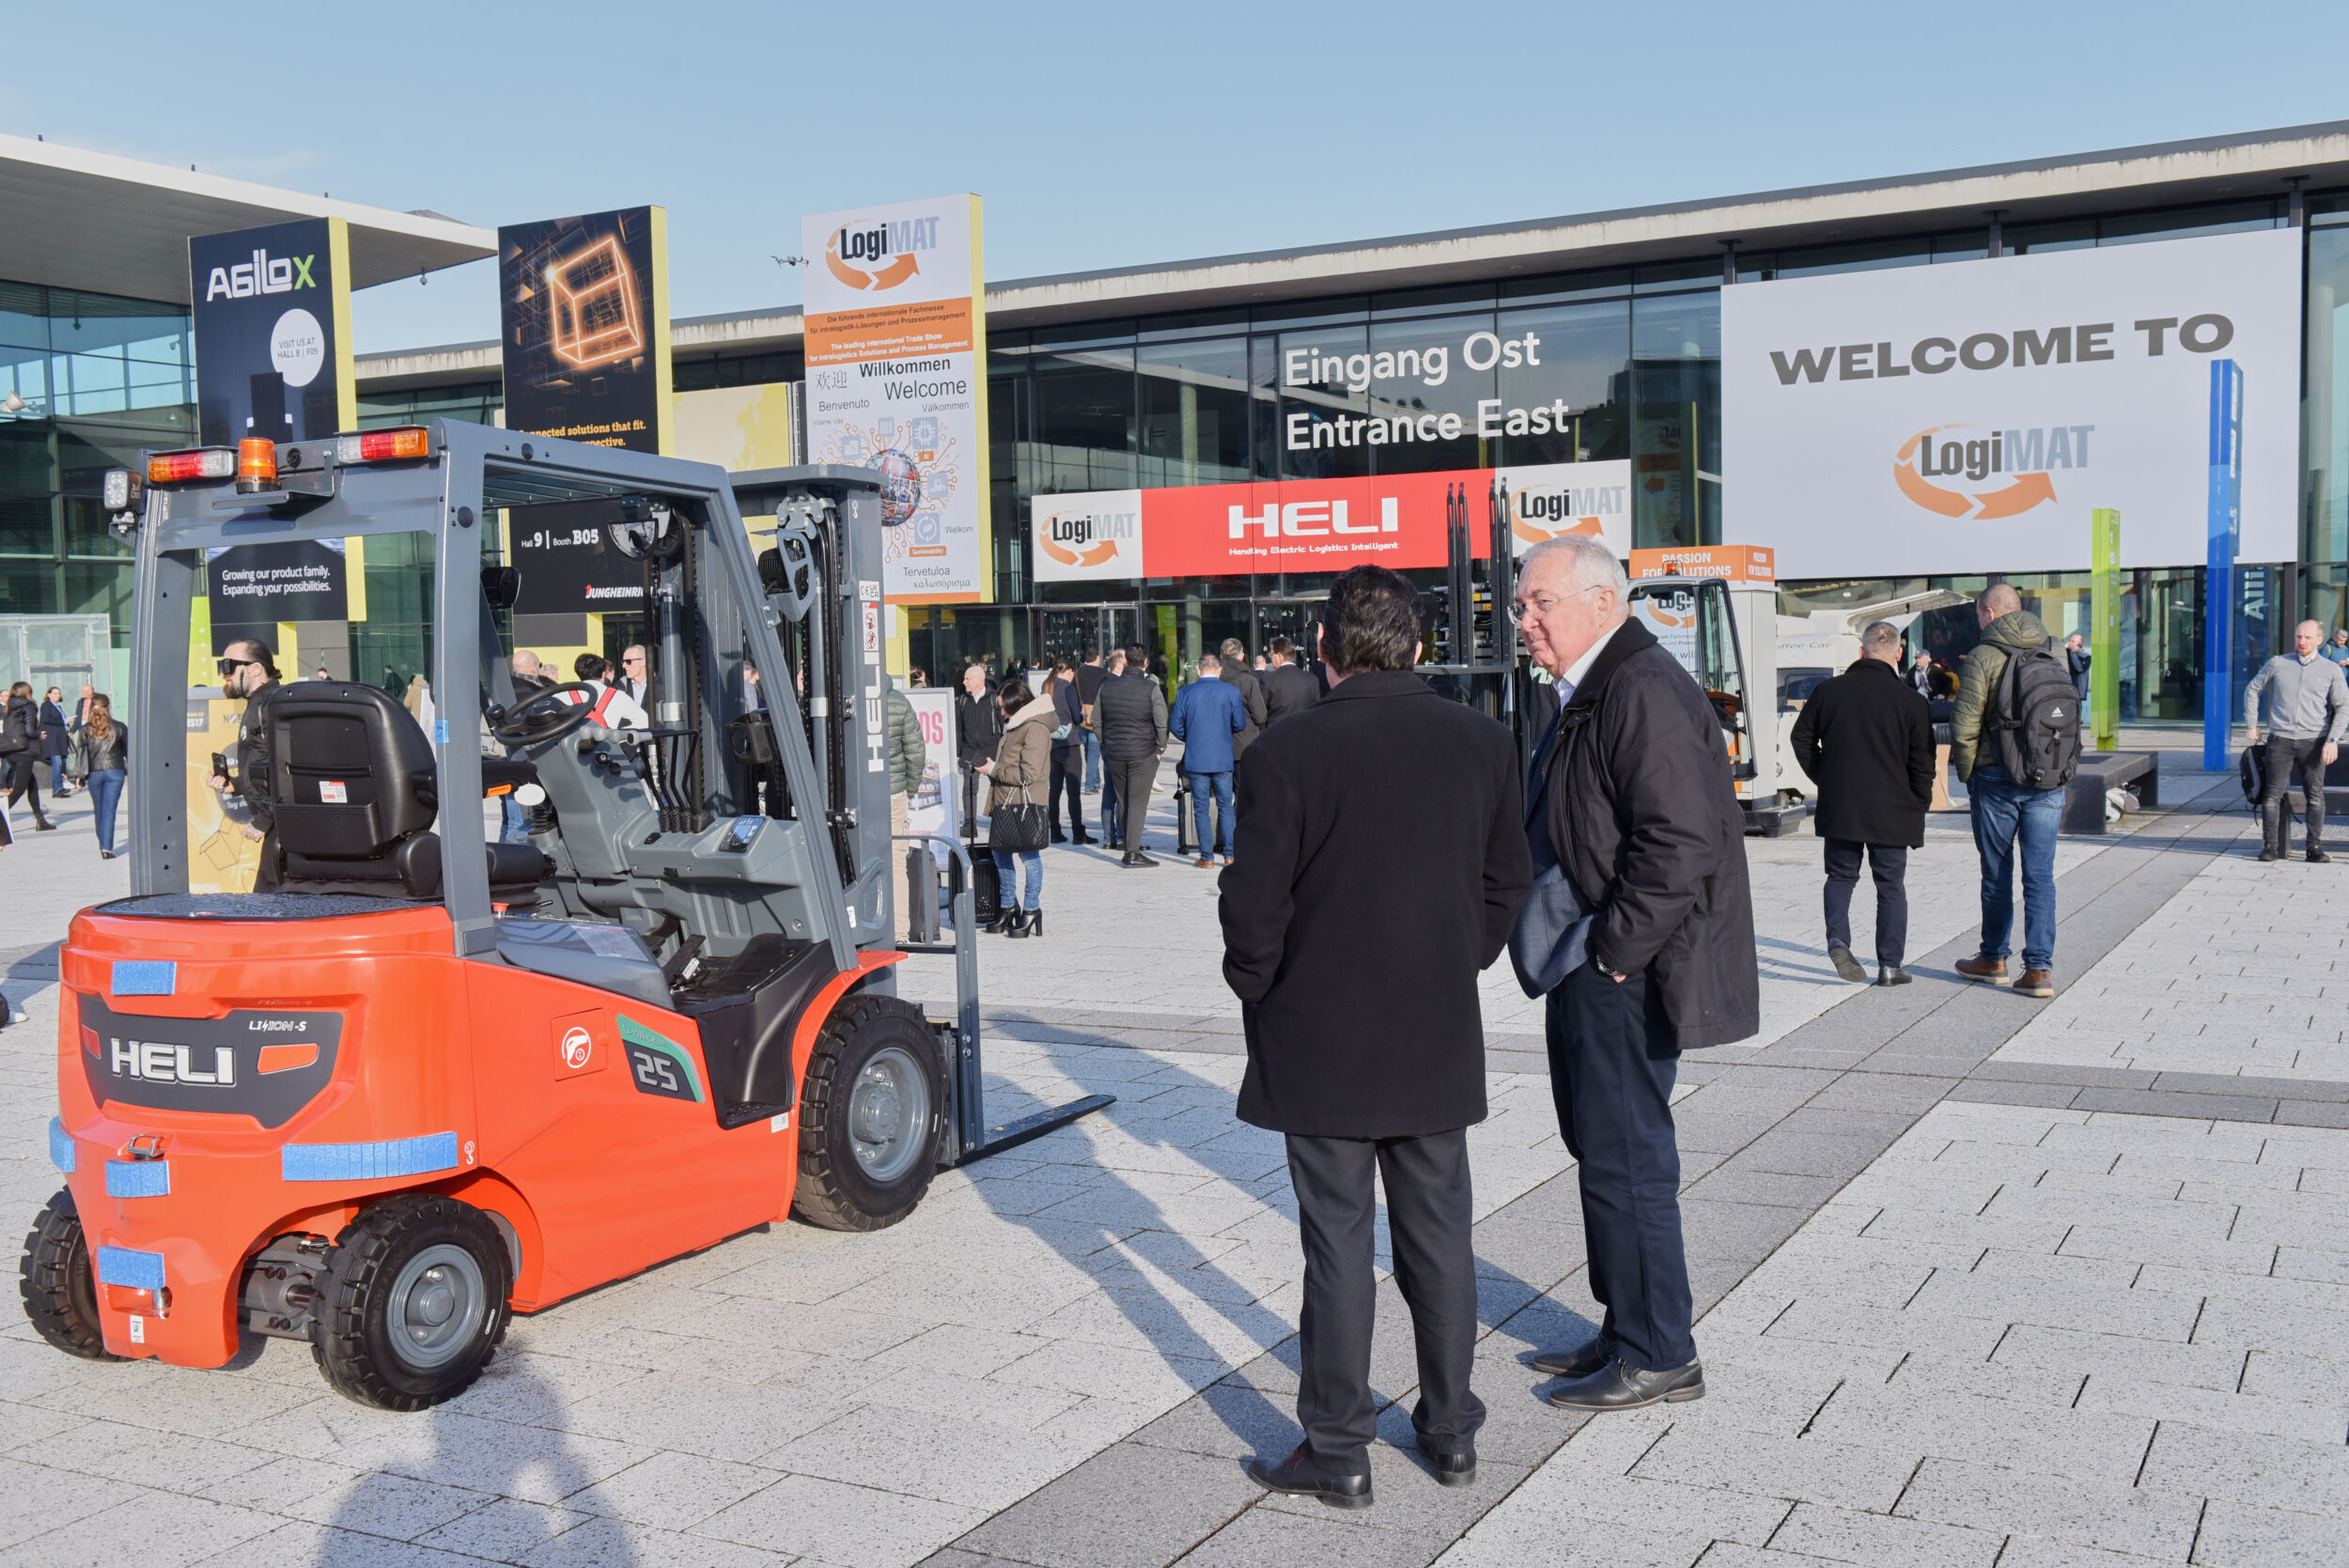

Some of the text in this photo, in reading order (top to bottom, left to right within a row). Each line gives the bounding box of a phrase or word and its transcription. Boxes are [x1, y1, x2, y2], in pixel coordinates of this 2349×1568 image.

[840, 216, 940, 261] LogiMAT
[900, 311, 966, 324] Prozessmanagement
[909, 304, 944, 313] Fachmesse
[278, 337, 316, 349] VISIT US AT
[818, 351, 857, 361] Intralogistics
[859, 349, 887, 357] Solutions
[927, 340, 969, 349] Management
[1769, 313, 2234, 385] WELCOME TO
[859, 359, 951, 378] Willkommen
[1285, 332, 1540, 392] Eingang Ost
[815, 370, 848, 391] 欢迎
[884, 380, 967, 401] Welcome
[818, 398, 870, 412] Benvenuto
[567, 422, 611, 436] solutions
[612, 421, 631, 431] that
[632, 419, 646, 430] fit.
[1287, 398, 1569, 451] Entrance East
[1921, 424, 2095, 481] LogiMAT
[1520, 486, 1626, 521] LogiMAT
[1052, 512, 1136, 544] LogiMAT
[1228, 497, 1399, 539] HELI
[521, 528, 599, 548] Hall 9 Booth B05
[1229, 541, 1399, 556] Handling Electric Logistics Intelligent
[1662, 552, 1711, 564] PASSION
[222, 565, 331, 582] Growing our product family.
[903, 566, 951, 577] Tervetuloa
[1642, 567, 1663, 578] FOR
[223, 581, 332, 598] Expanding your possibilities.
[863, 652, 884, 772] HELI
[111, 1037, 236, 1087] HELI
[633, 1051, 678, 1092] 25
